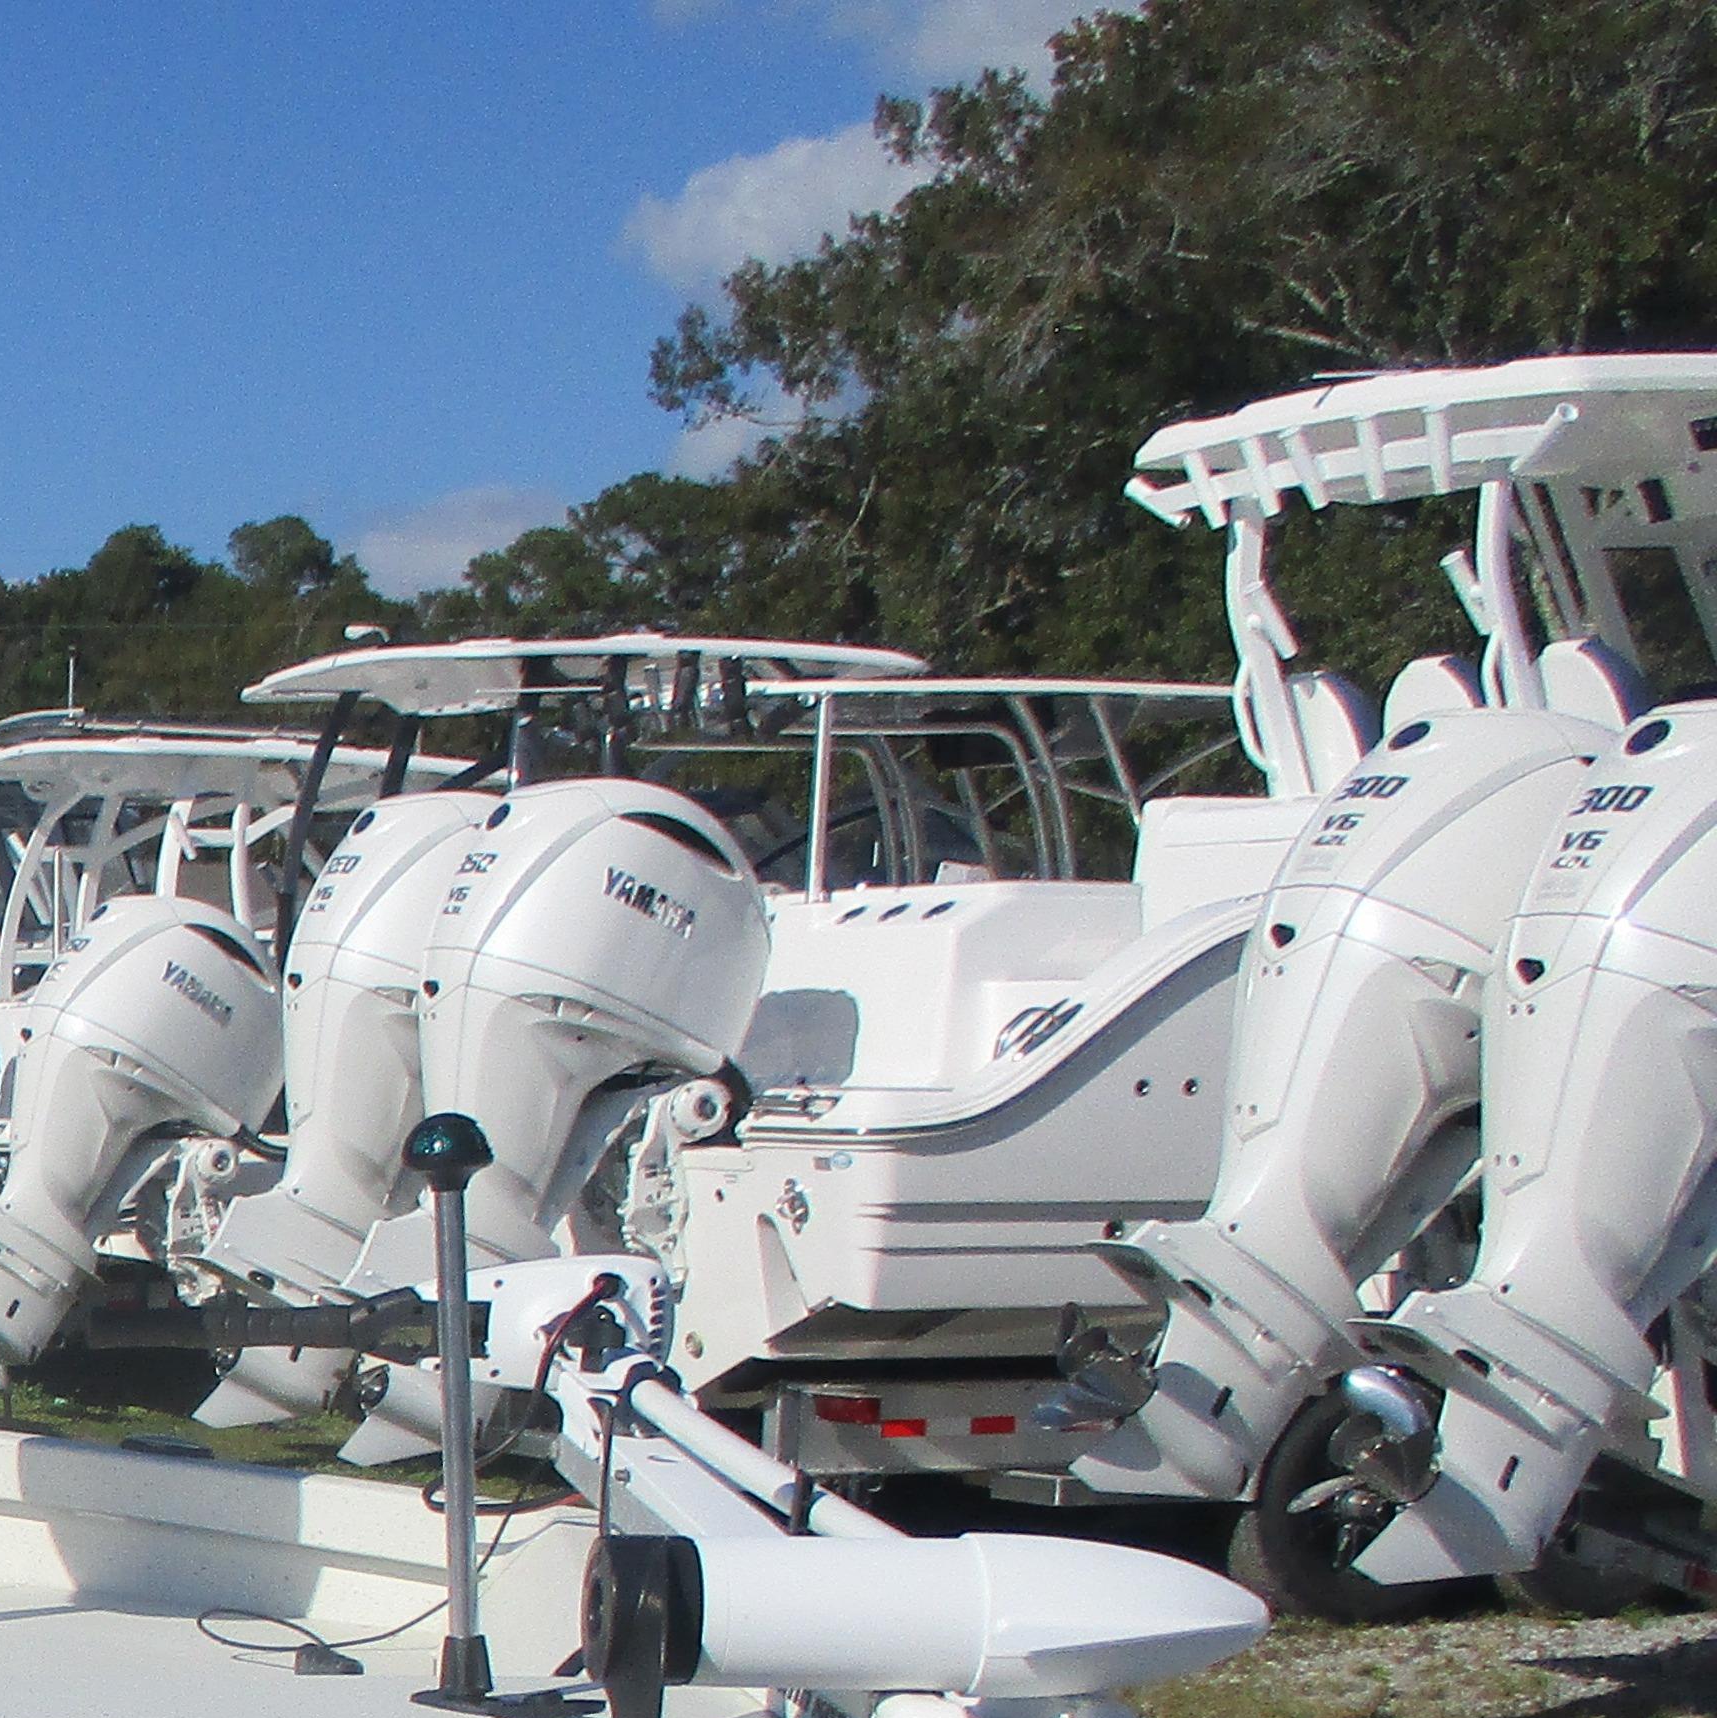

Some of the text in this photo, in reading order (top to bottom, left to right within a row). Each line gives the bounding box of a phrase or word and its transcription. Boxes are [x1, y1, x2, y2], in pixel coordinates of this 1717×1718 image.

[1331, 775, 1410, 802] 300
[1568, 785, 1654, 817] 300
[1320, 813, 1365, 832] V6
[1559, 830, 1609, 852] V6
[603, 866, 696, 940] YAMAHA
